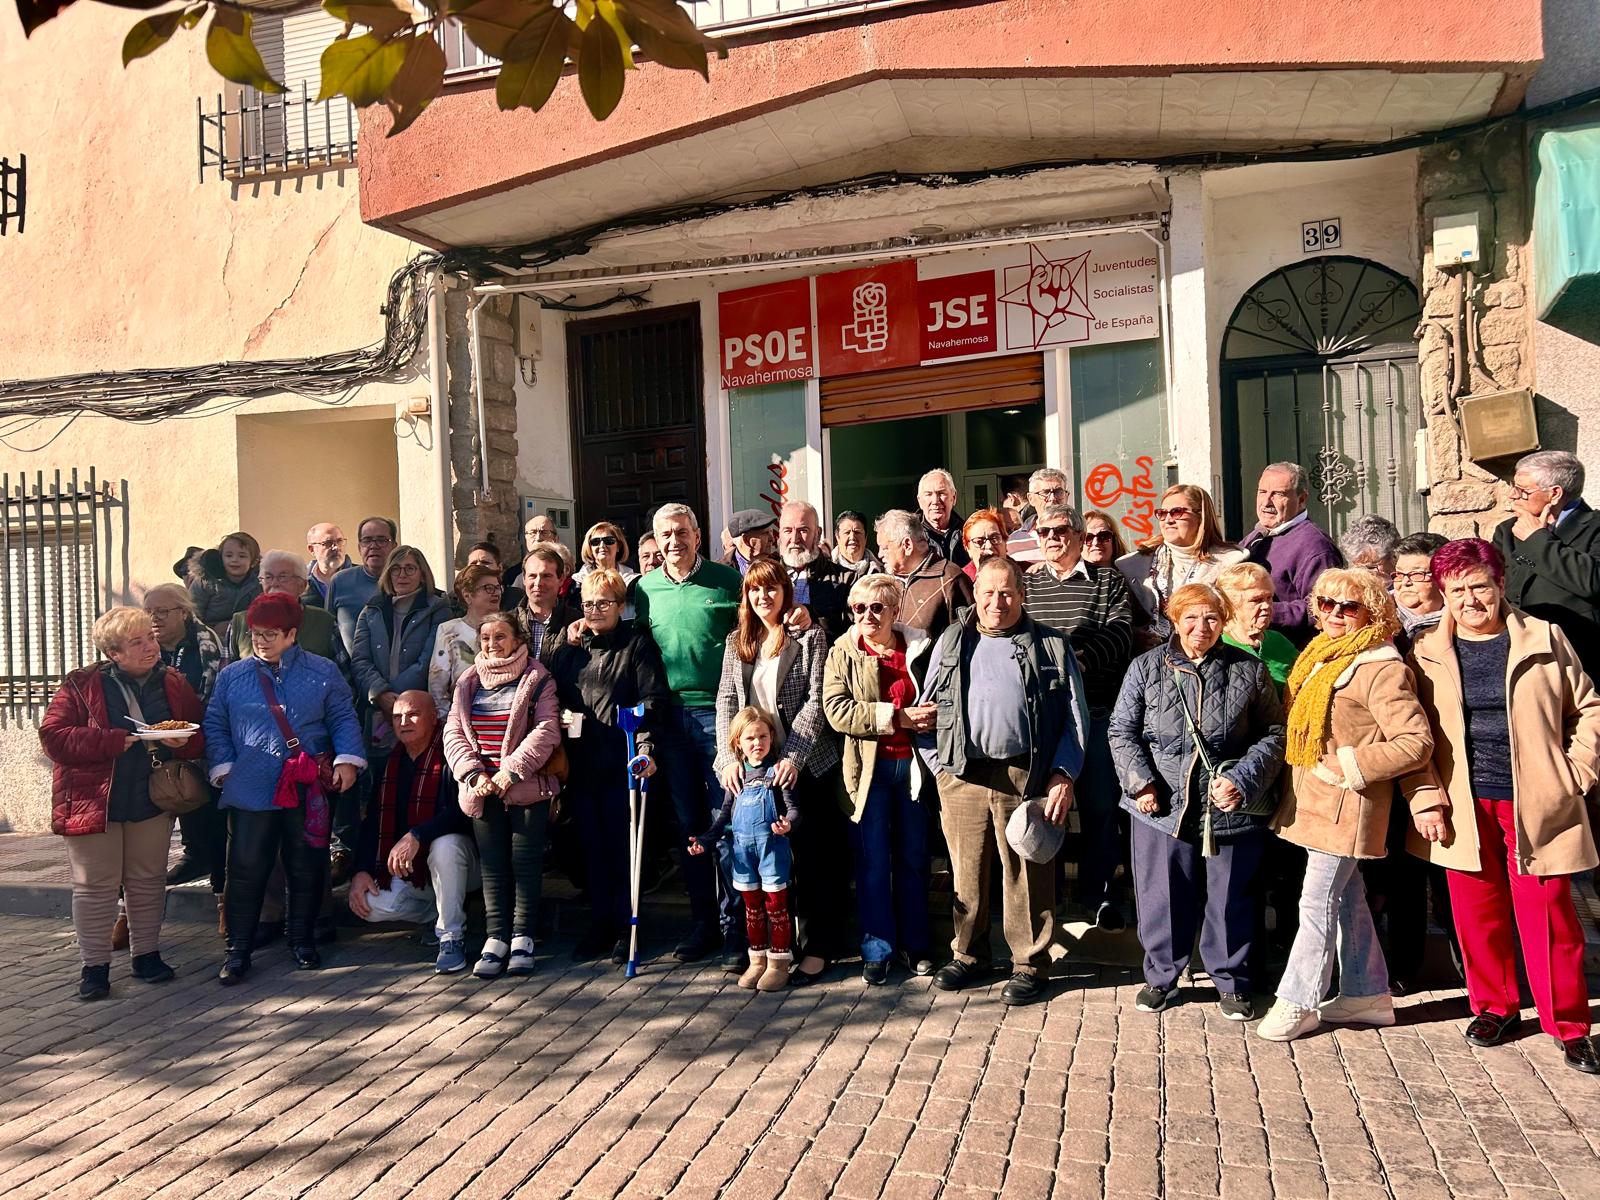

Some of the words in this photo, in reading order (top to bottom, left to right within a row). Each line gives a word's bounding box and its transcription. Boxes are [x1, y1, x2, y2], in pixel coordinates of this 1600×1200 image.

[1305, 224, 1339, 247] 39
[1092, 256, 1157, 273] Juventudes
[1093, 284, 1154, 299] Socialistas
[926, 293, 989, 332] JSE
[1094, 319, 1109, 330] de
[1111, 314, 1154, 330] España
[724, 326, 807, 370] PSOE
[928, 335, 989, 350] Navahermosa
[721, 366, 813, 388] Navahermosa
[759, 460, 789, 524] des
[1120, 455, 1158, 548] listas
